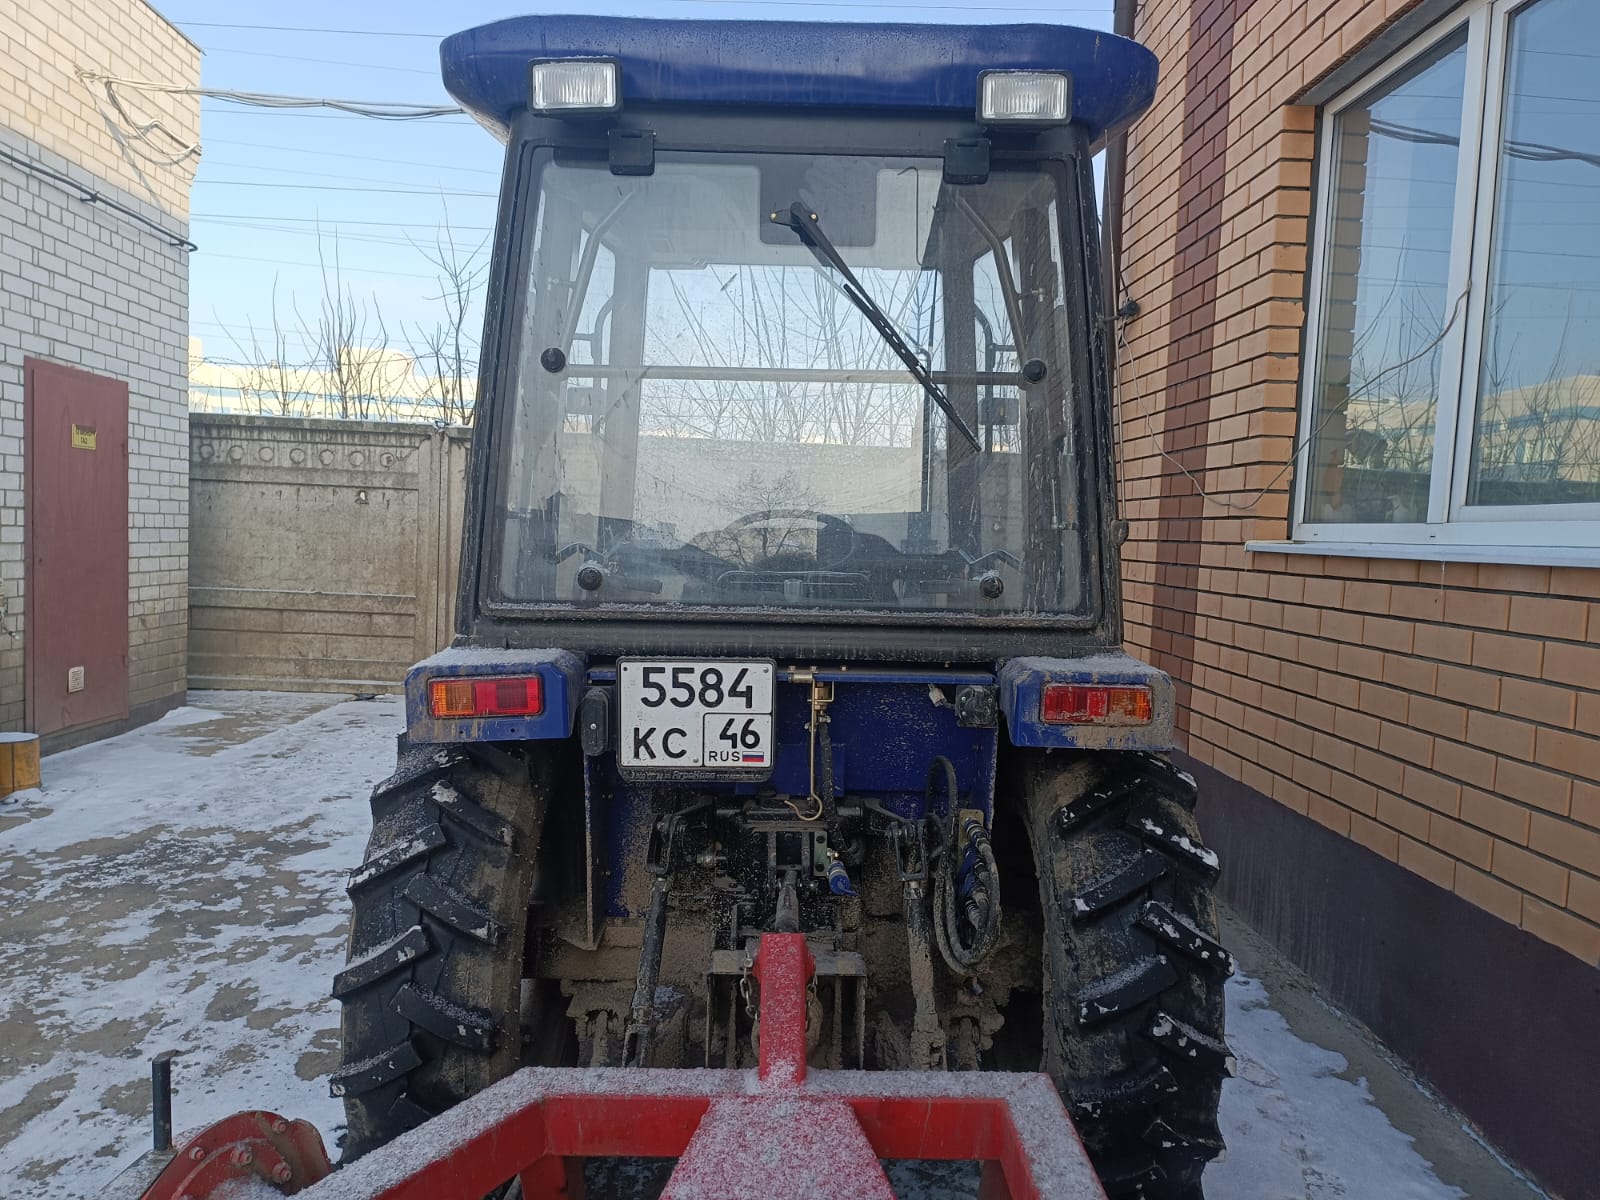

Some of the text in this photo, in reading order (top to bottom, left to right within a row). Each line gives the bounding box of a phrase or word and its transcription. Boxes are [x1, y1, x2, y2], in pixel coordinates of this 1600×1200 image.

[641, 667, 753, 709] 5584
[633, 727, 688, 760] КС
[719, 718, 761, 749] 46
[708, 751, 740, 762] RUS
